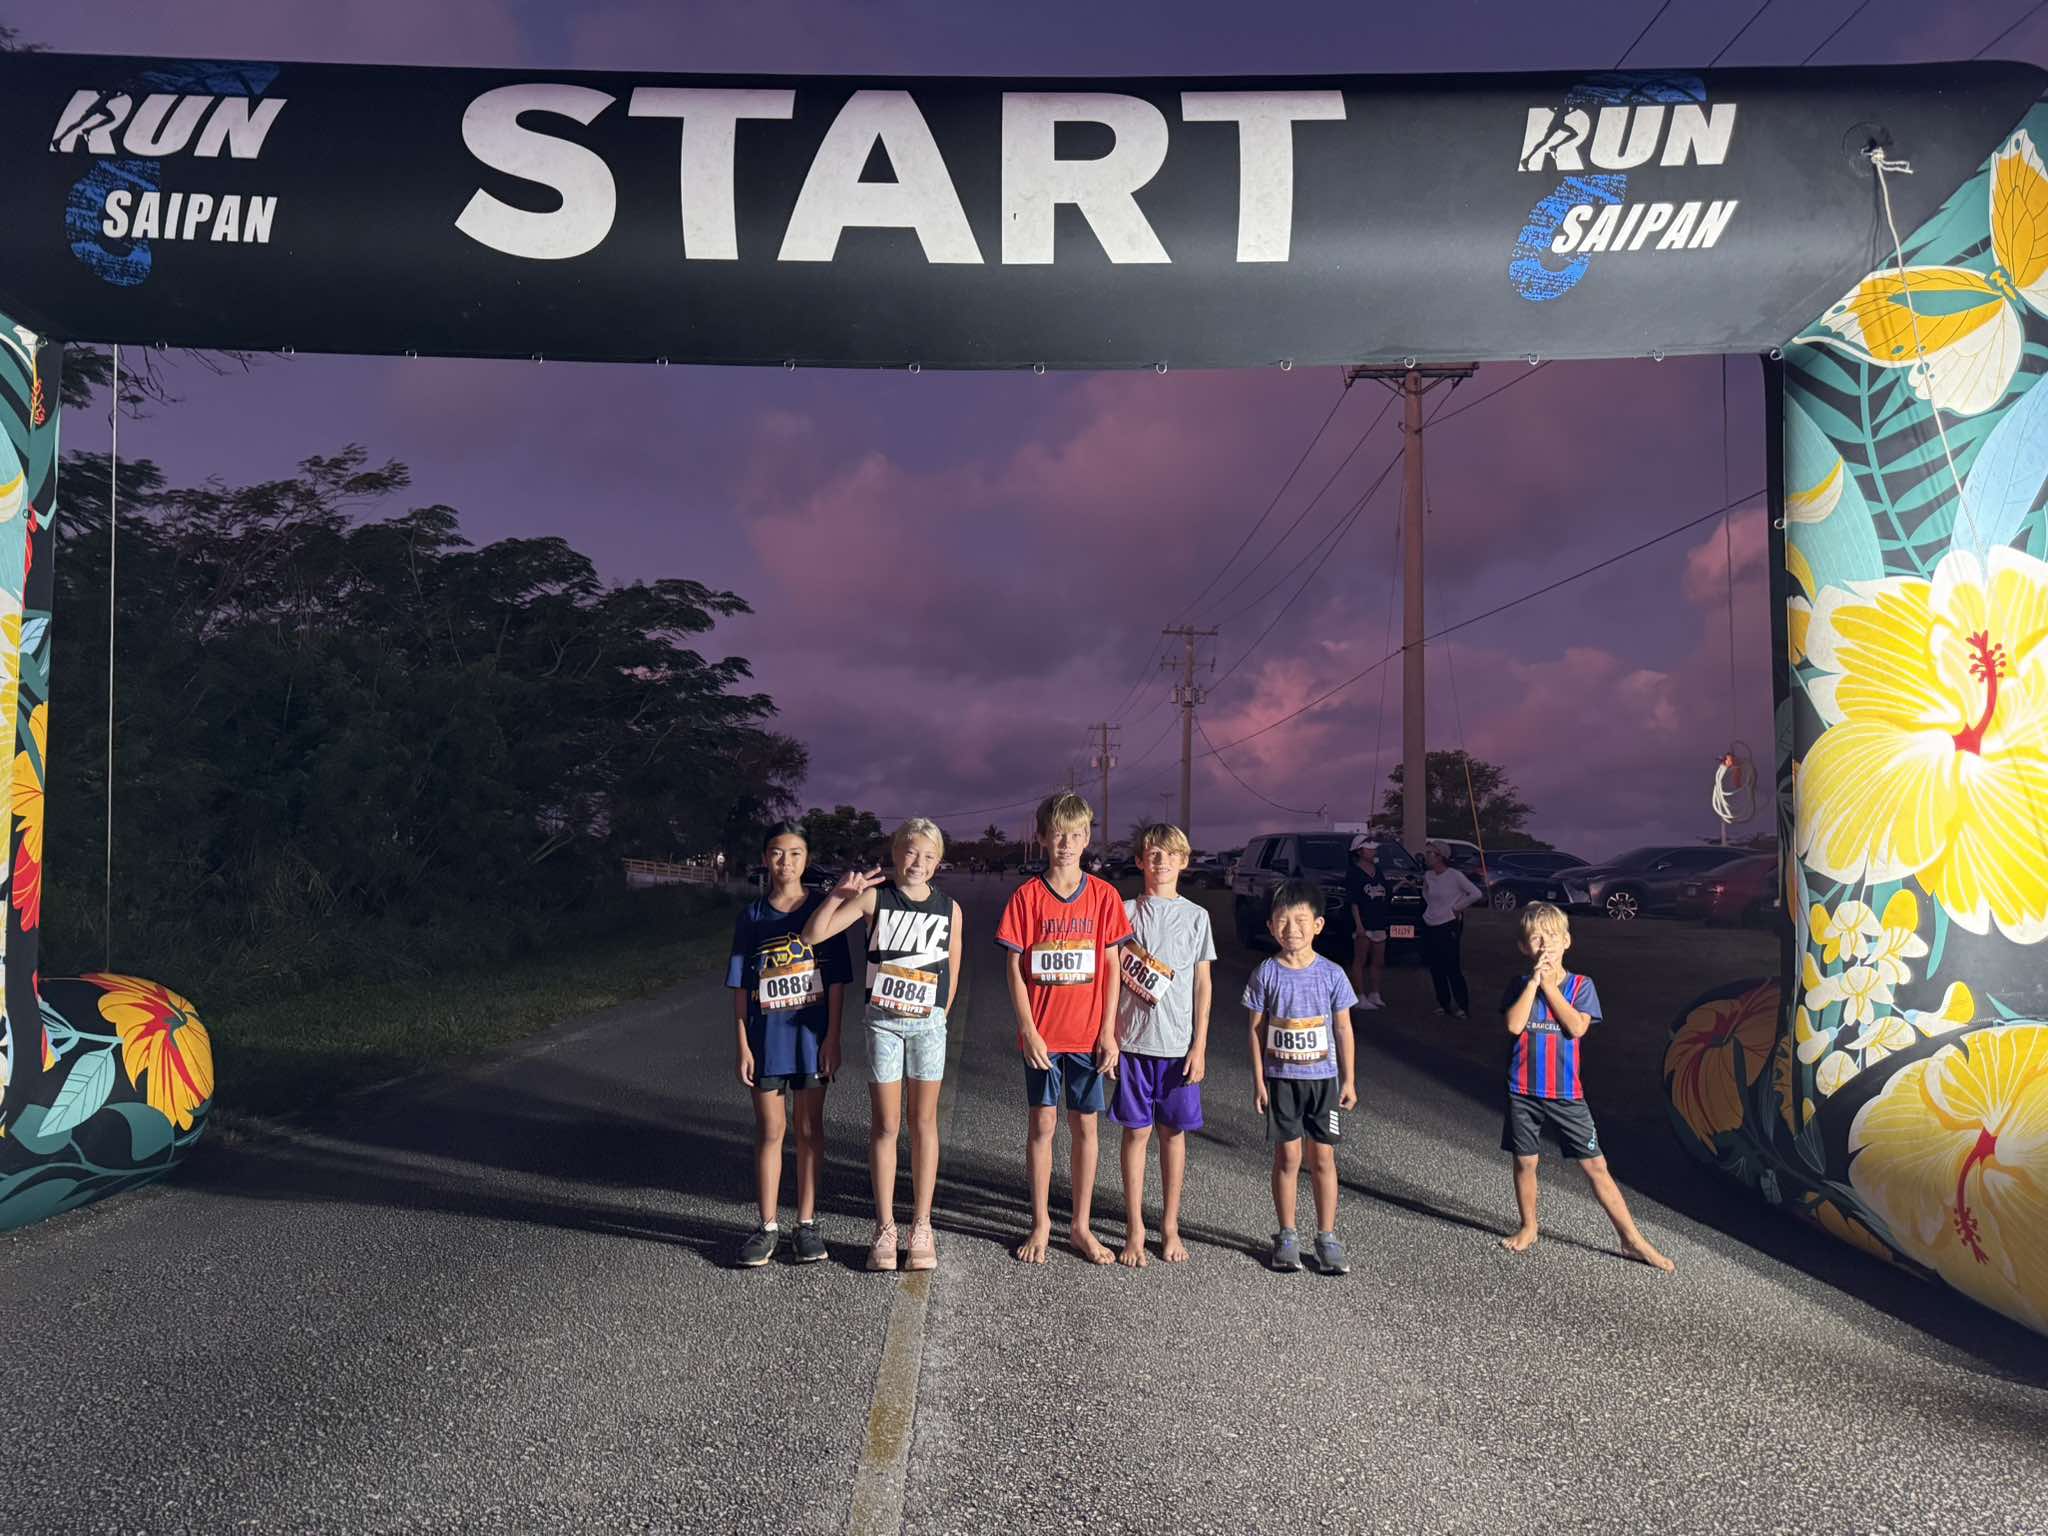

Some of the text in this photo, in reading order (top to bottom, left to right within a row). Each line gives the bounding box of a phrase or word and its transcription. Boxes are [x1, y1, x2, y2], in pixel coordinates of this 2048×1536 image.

[49, 89, 288, 159] RUN
[1518, 103, 1737, 171] RUN
[454, 82, 1348, 265] START
[102, 189, 278, 243] SAIPAN
[1551, 200, 1739, 254] SAIPAN
[878, 908, 949, 953] NIKE
[1040, 918, 1094, 934] HOLLAND
[1041, 952, 1083, 970] 0867
[1123, 954, 1159, 990] 0868
[881, 977, 927, 1003] 0884
[1274, 1030, 1317, 1049] 0859
